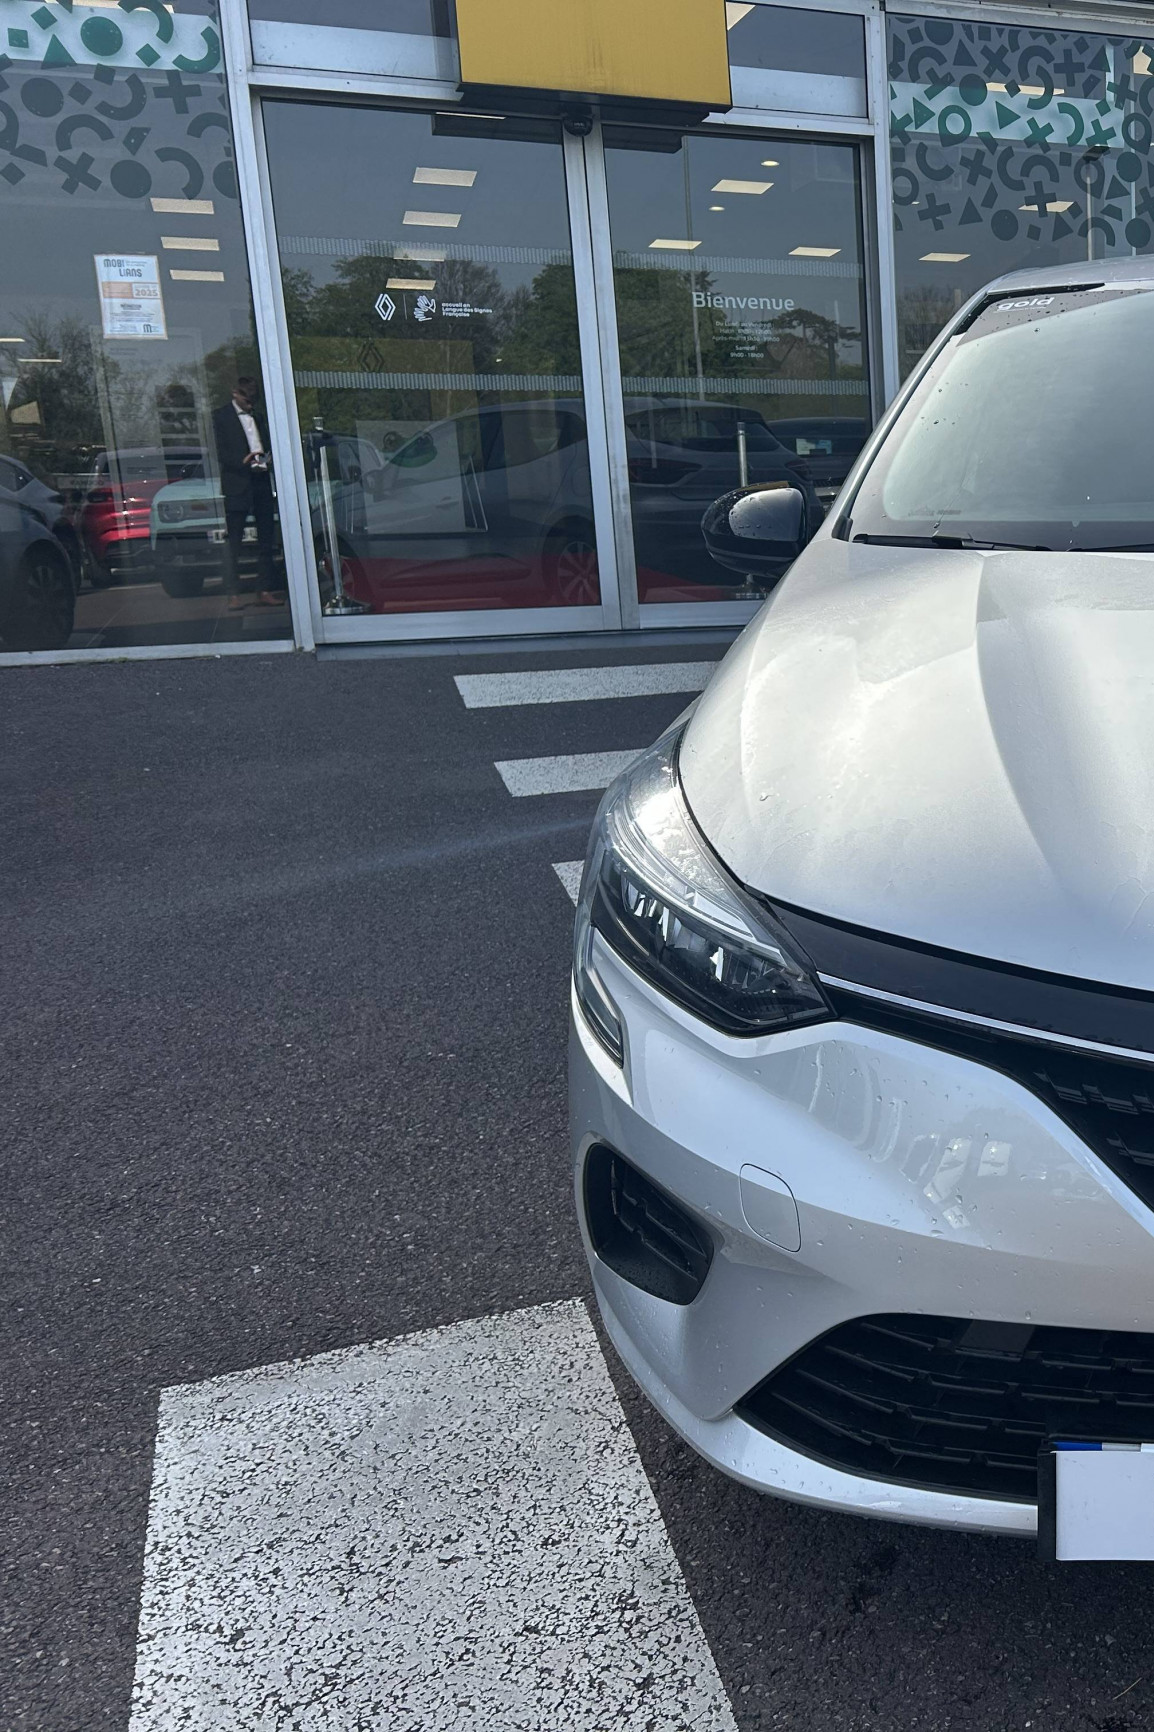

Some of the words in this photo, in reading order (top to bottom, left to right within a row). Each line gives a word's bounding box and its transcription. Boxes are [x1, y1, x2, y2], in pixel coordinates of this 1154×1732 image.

[103, 259, 125, 268] MOBI
[119, 268, 143, 277] LIANS
[134, 289, 158, 297] 2025
[691, 291, 796, 311] Bienvenue
[998, 296, 1055, 311] gold
